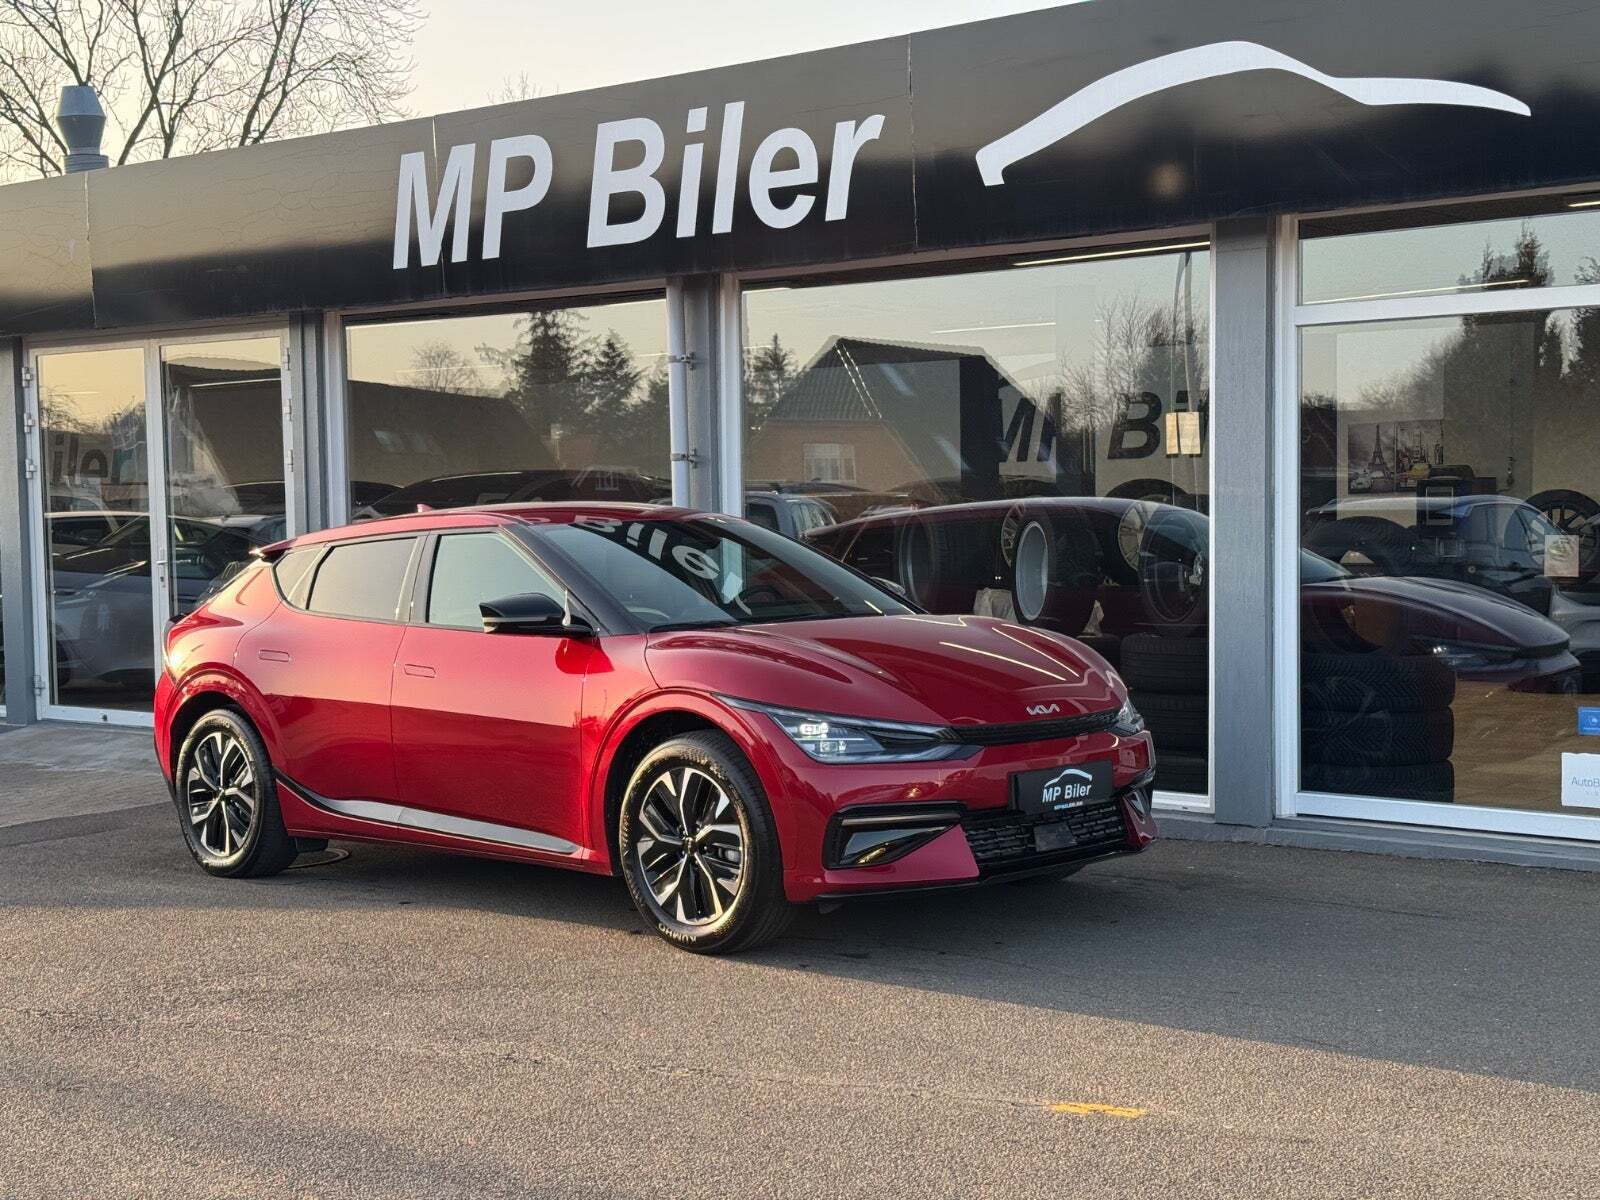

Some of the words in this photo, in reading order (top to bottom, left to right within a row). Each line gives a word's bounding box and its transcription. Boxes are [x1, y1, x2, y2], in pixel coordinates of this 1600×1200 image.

[392, 133, 554, 270] MP
[586, 100, 886, 249] Biler
[1026, 703, 1061, 716] KIA
[1042, 786, 1061, 803] MP
[1064, 783, 1092, 800] Biler
[659, 923, 697, 942] KUMHO
